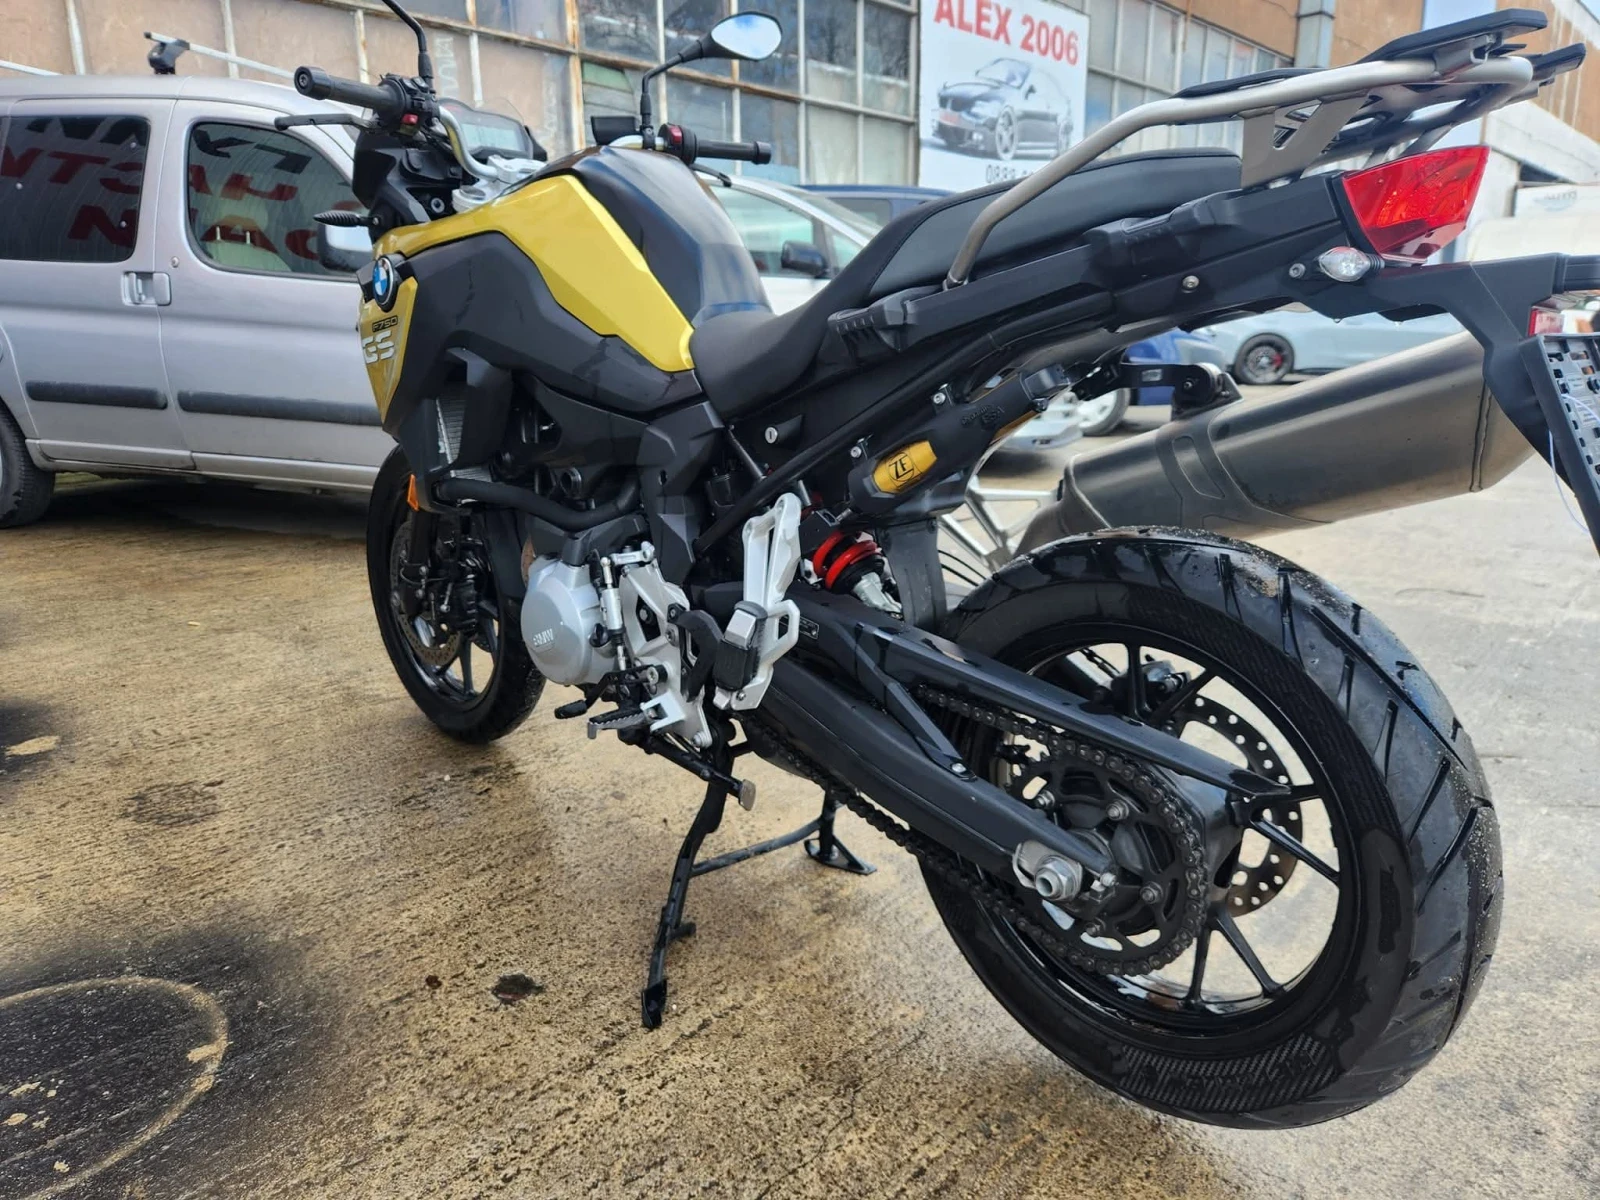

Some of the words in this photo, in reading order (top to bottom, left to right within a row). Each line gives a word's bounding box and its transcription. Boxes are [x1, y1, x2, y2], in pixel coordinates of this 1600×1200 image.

[934, 0, 1012, 46] ALEX
[1020, 13, 1079, 66] 2006
[373, 315, 398, 332] F750
[362, 329, 395, 364] GS
[888, 453, 914, 480] ZF
